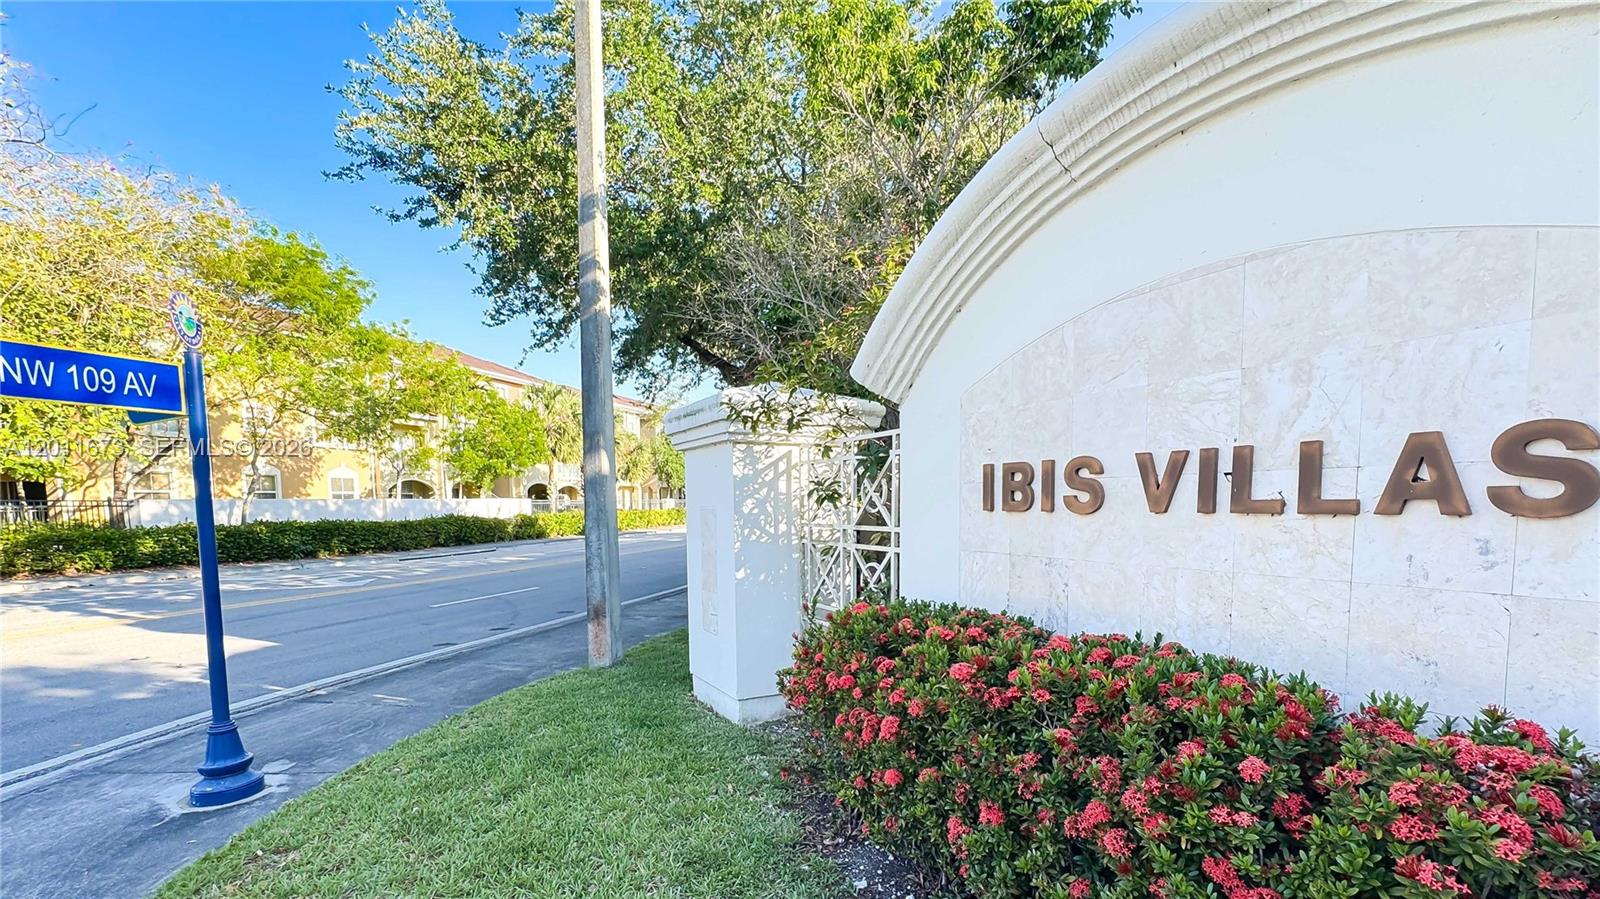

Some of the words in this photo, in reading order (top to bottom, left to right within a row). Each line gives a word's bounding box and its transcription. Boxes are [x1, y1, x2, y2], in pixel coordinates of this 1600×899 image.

[0, 354, 55, 387] NW
[66, 364, 116, 394] 109
[123, 371, 157, 398] AV
[982, 456, 1105, 515] IBIS
[1135, 418, 1600, 518] VILLAS
